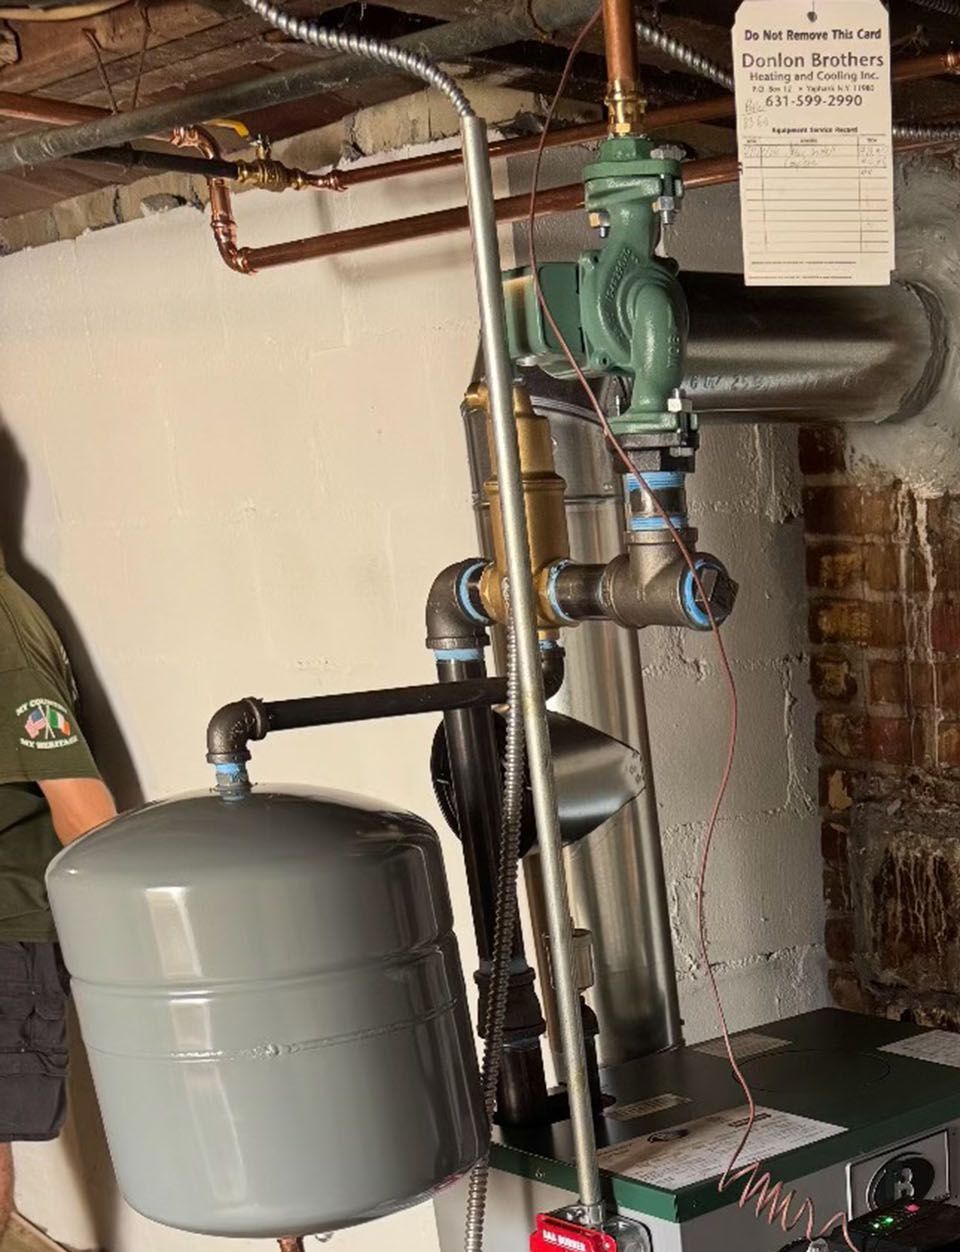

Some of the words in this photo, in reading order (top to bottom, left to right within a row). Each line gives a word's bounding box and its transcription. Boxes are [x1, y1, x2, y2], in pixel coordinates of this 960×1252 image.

[745, 30, 759, 40] Do
[763, 30, 783, 40] Not
[787, 29, 828, 40] Remove
[832, 29, 853, 39] This
[857, 28, 882, 39] Card
[742, 52, 804, 68] Donlon
[811, 51, 884, 67] Brothers
[750, 71, 791, 84] Heating
[794, 71, 813, 81] and
[817, 71, 857, 82] Cooling
[860, 71, 879, 80] Inc.
[765, 94, 863, 107] 631-599-2990
